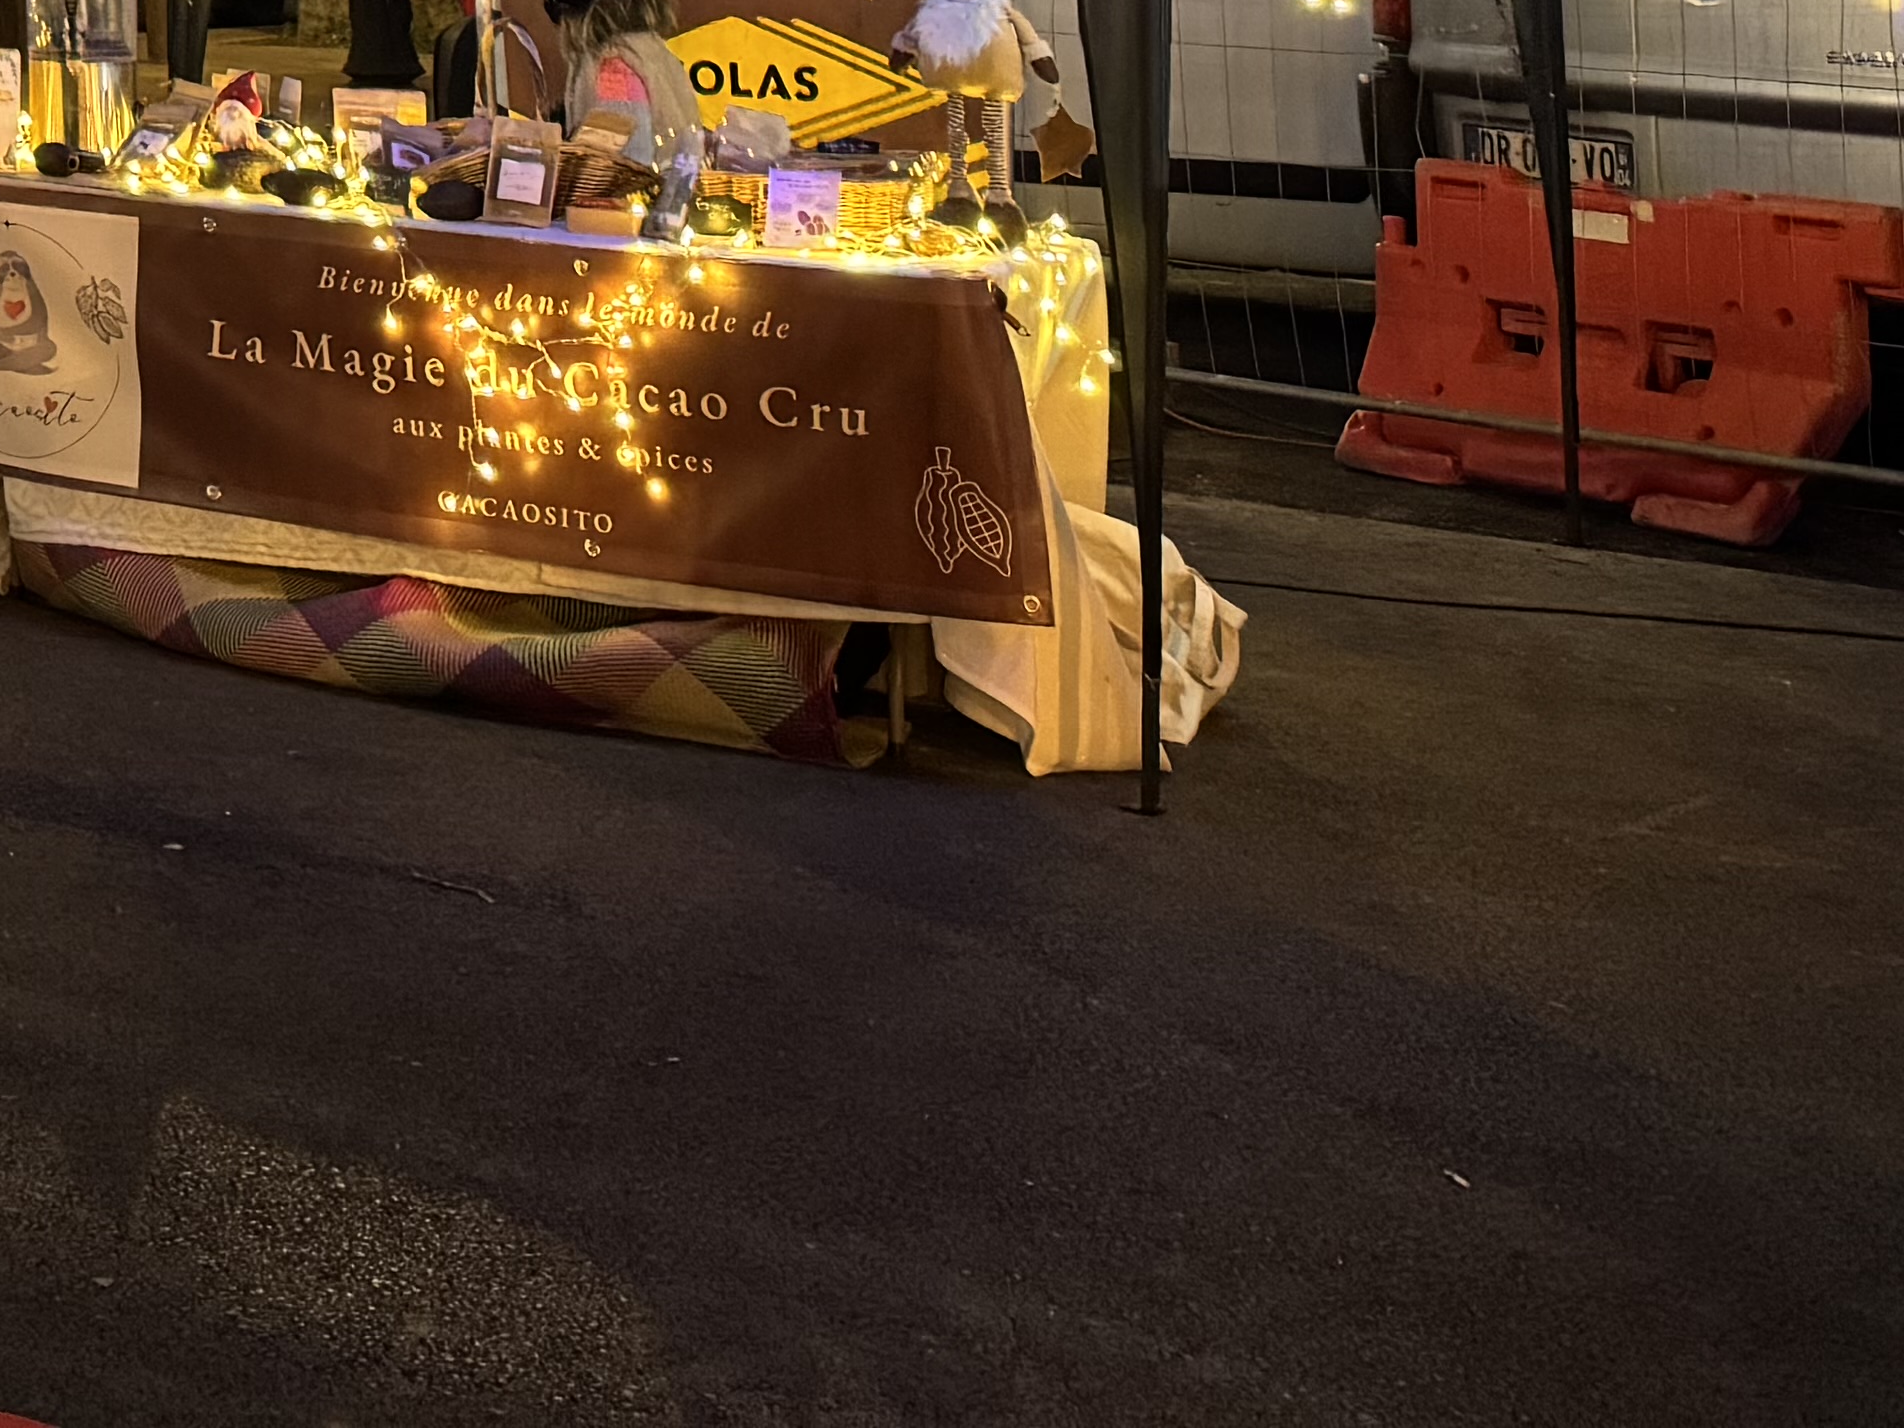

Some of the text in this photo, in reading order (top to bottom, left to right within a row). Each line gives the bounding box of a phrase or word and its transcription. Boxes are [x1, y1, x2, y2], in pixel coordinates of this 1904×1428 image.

[686, 59, 819, 102] OLAS
[318, 266, 790, 341] Bienvenue dans le monde de
[208, 319, 869, 437] La Magie du Cacao Cru
[392, 416, 444, 441] aux
[578, 436, 601, 462] &
[616, 441, 713, 475] épices
[437, 489, 614, 535] CACAOSITO
